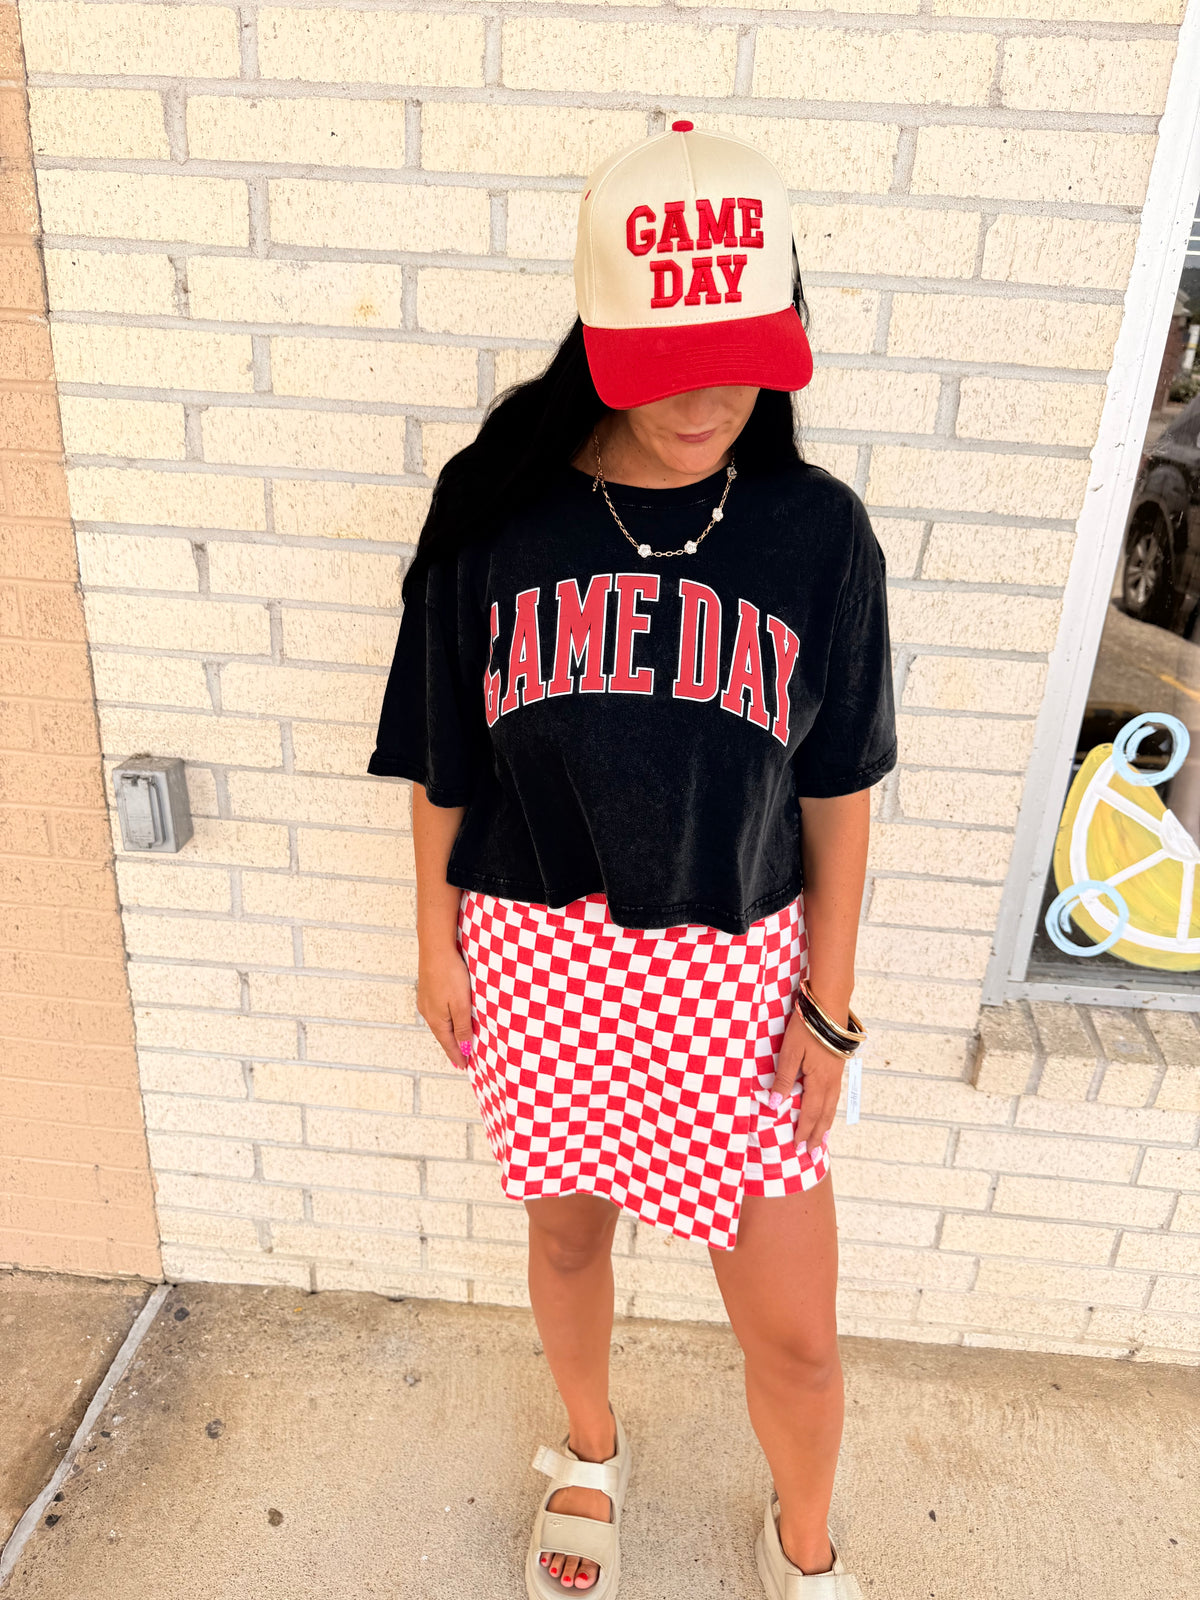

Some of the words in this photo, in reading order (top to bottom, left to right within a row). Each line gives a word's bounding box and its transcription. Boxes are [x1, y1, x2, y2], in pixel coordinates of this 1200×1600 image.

[626, 197, 764, 257] GAME
[650, 254, 748, 309] DAY
[672, 578, 800, 747] DAY
